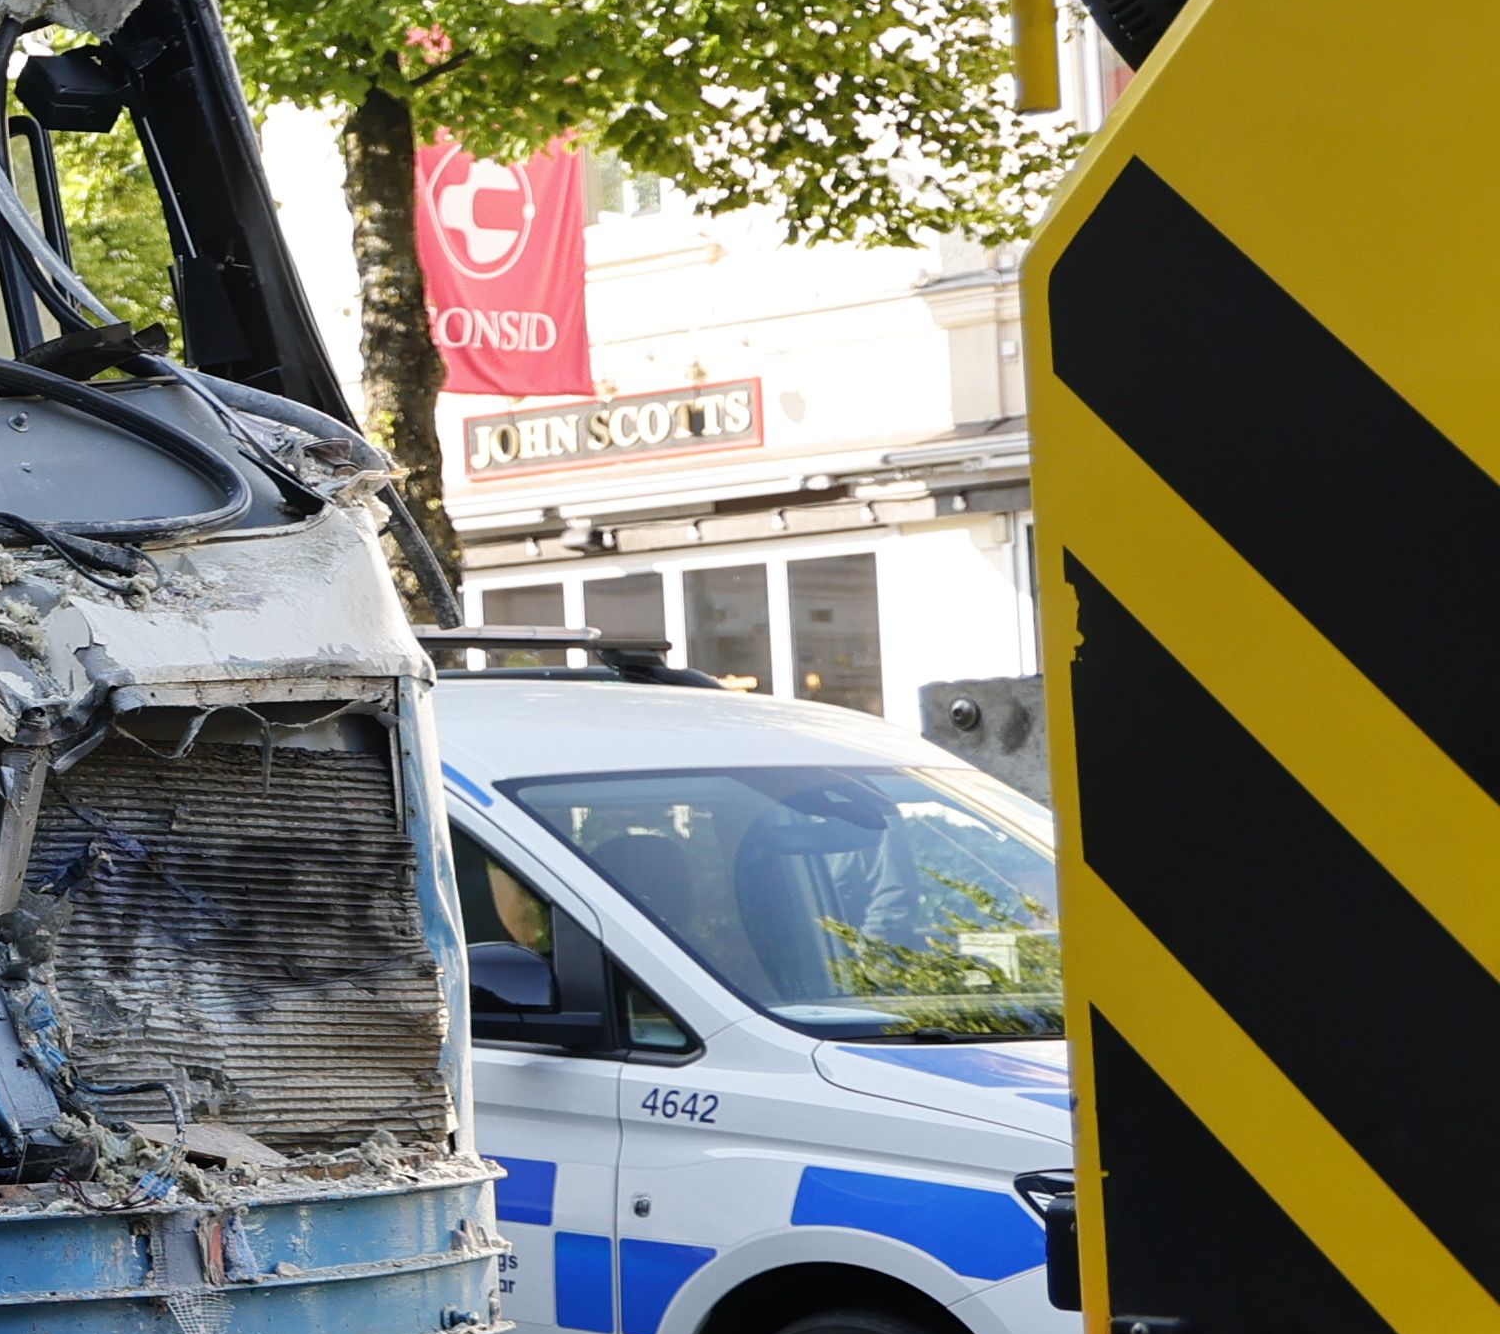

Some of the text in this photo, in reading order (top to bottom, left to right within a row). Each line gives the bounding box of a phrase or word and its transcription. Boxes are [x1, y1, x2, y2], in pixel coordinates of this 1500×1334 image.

[470, 390, 751, 469] JOHN SCOTTS
[641, 1087, 719, 1124] 4642
